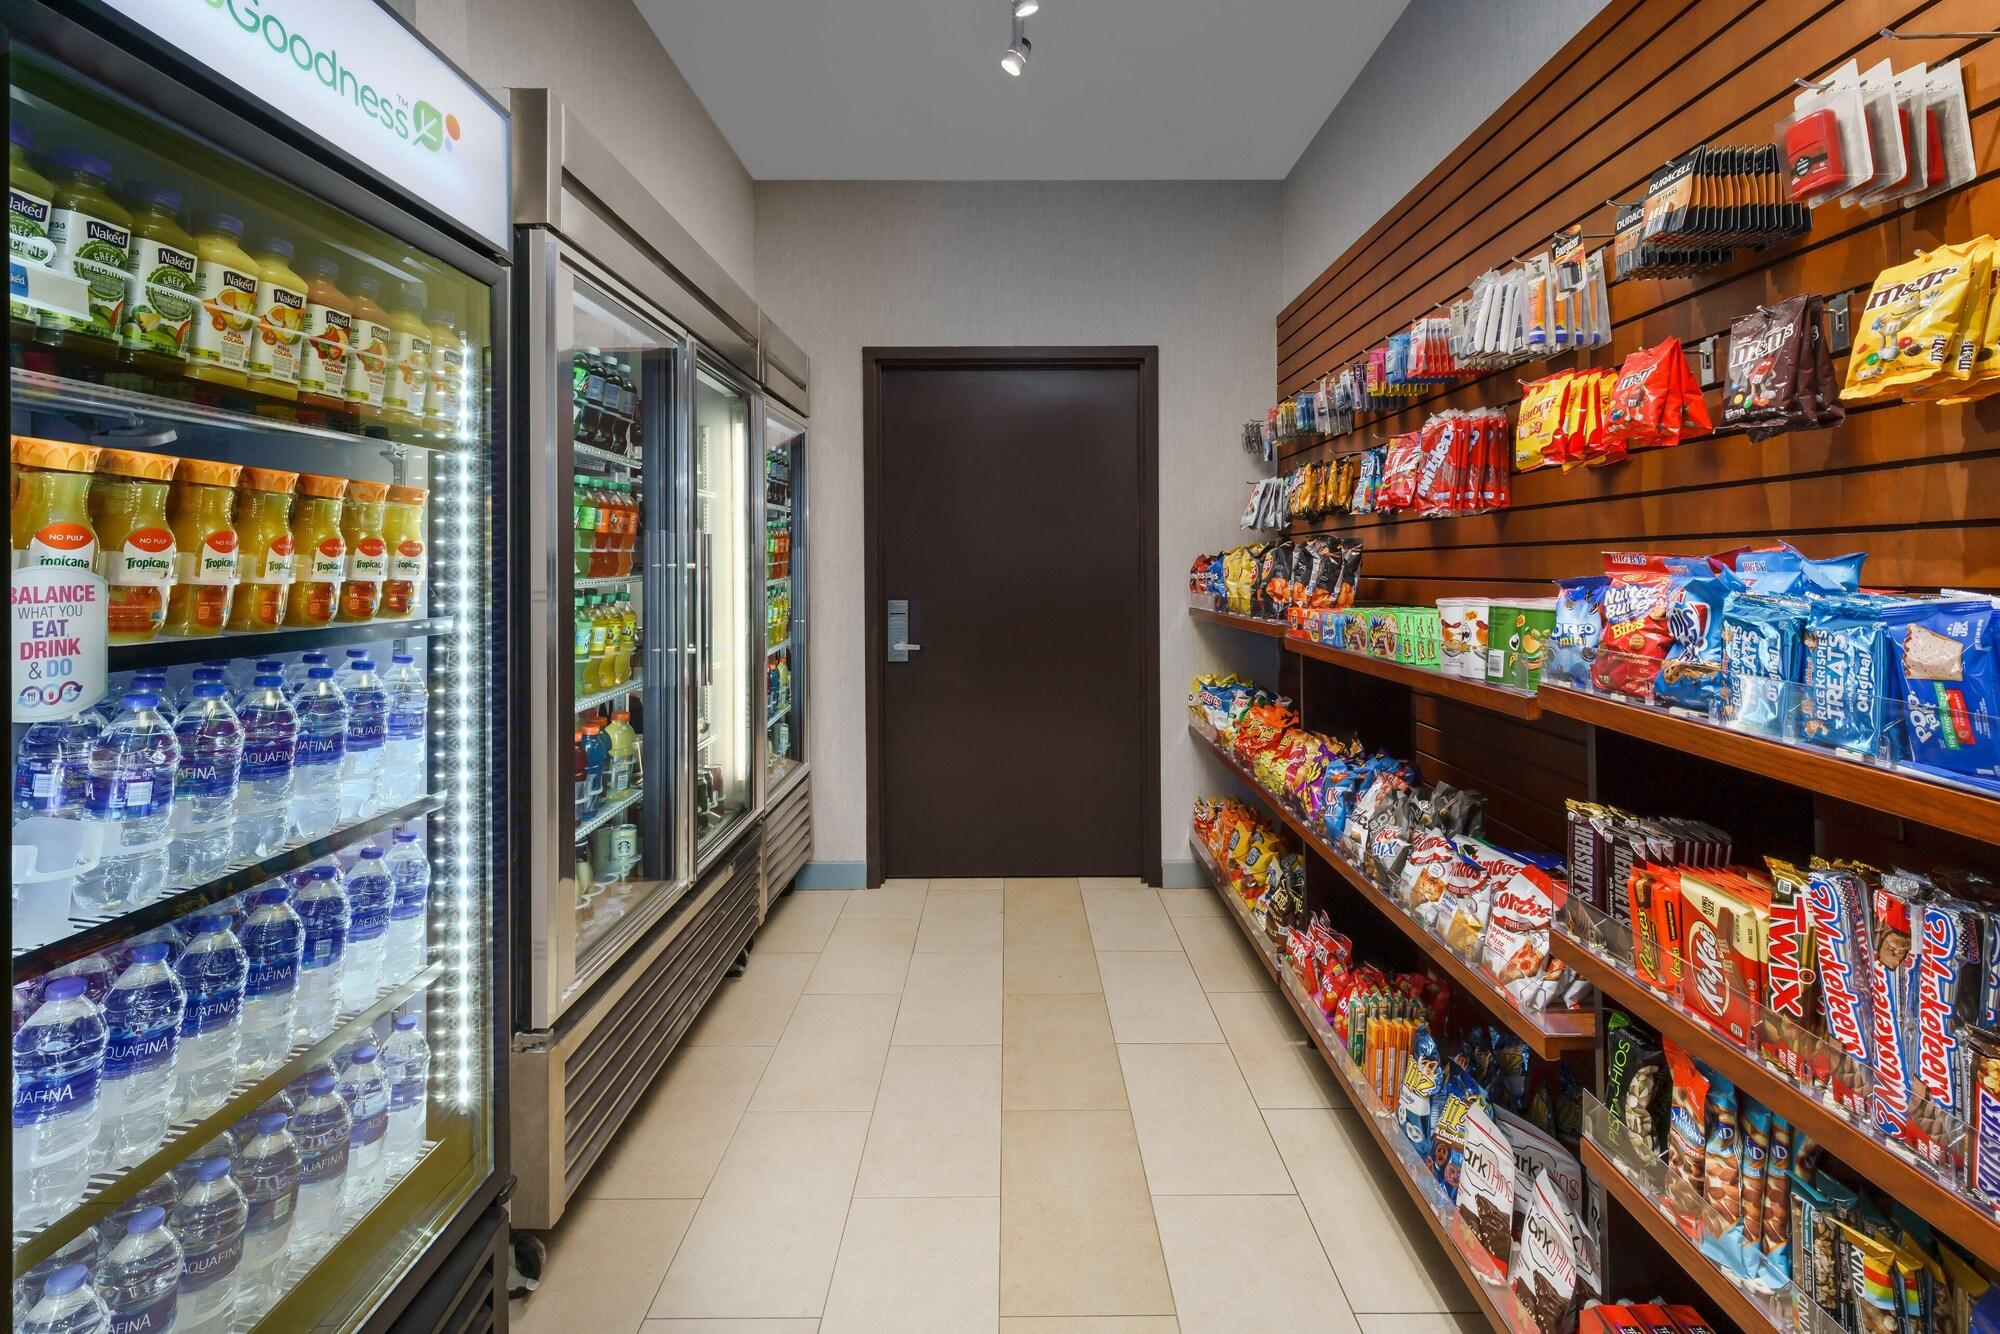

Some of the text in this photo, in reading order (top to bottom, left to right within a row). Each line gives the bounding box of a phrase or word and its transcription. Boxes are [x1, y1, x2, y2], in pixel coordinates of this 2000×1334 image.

[226, 0, 409, 140] Goodness
[1648, 161, 1693, 194] DURACELL
[1616, 207, 1646, 231] DURACE
[90, 223, 126, 246] Naked
[94, 252, 121, 267] GREEN
[161, 250, 192, 273] Naked
[10, 273, 25, 285] ked
[162, 276, 186, 290] GREEN
[225, 273, 253, 291] Naked
[276, 291, 301, 308] Naked
[327, 312, 349, 328] Naked
[49, 533, 64, 541] NO
[126, 557, 170, 570] Tropicana
[204, 557, 235, 569] Tropican
[316, 561, 341, 572] Tropica
[1611, 553, 1647, 565] BIG BAG
[1743, 561, 1756, 572] BIG
[11, 584, 96, 605] BALANCE
[1604, 584, 1661, 606] Nutter
[18, 605, 83, 619] WHAT YOU
[1605, 598, 1651, 618] Butter
[1551, 623, 1596, 640] OREO
[1611, 619, 1646, 640] Bites
[20, 638, 81, 660] DRINK
[1558, 636, 1587, 646] mini
[1740, 630, 1759, 677] EATS
[28, 658, 73, 680] & DO
[1815, 630, 1828, 721] RICE KRISPIES
[1826, 633, 1848, 721] TREATS
[346, 725, 387, 737] AQUAFIN
[298, 740, 334, 752] UAFINA
[241, 750, 292, 764] AQUAFIN
[177, 766, 217, 780] AFINA
[1574, 825, 1594, 903] HERSHEY'S
[1489, 934, 1505, 947] pizza
[1769, 894, 1808, 1016] TWIX
[249, 966, 292, 985] UAFINA
[1812, 905, 1865, 1060] Musketeers
[1917, 937, 1953, 1106] Musketeers
[105, 1036, 169, 1060] QUAFINA
[1403, 1055, 1435, 1099] lipz
[15, 1084, 74, 1105] UAFINA
[1671, 1109, 1705, 1146] DIAMOND
[1876, 1100, 1907, 1140] 3
[1851, 1244, 1865, 1298] KIND
[107, 1313, 151, 1334] AFINA
